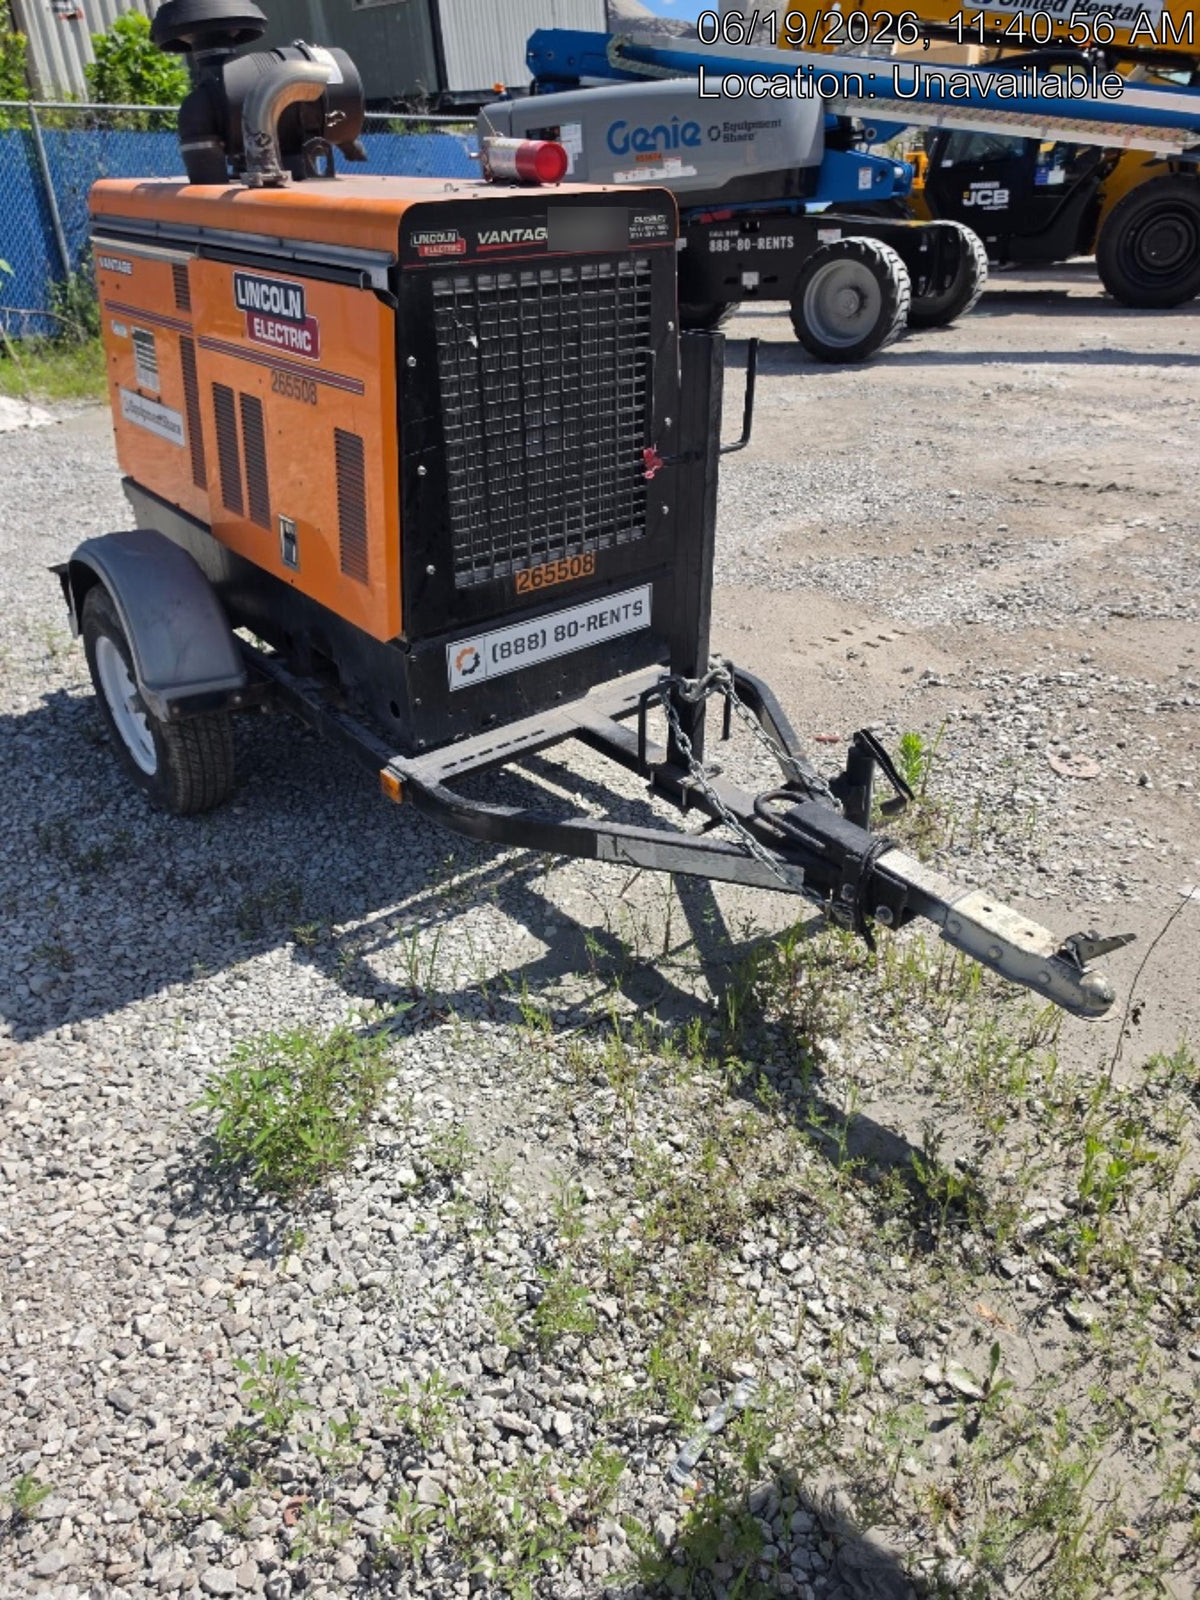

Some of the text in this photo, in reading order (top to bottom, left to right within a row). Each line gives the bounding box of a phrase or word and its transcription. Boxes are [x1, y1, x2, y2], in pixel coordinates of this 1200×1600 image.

[1071, 0, 1151, 21] Rental
[607, 115, 702, 155] Genie
[722, 118, 782, 134] Equipment
[723, 133, 756, 143] Share
[962, 188, 1010, 206] JCB
[413, 232, 456, 245] LINCOLN
[477, 226, 548, 244] VANTAG
[424, 244, 462, 254] ELECTRIC
[709, 236, 794, 253] 888-80-RENTS
[99, 257, 132, 275] VANTAGE
[236, 279, 303, 318] LINCOLN
[252, 318, 312, 352] ELECTRIC
[271, 371, 318, 406] 265508
[517, 554, 594, 592] 265508
[491, 600, 644, 664] (888) 80-RENTS
